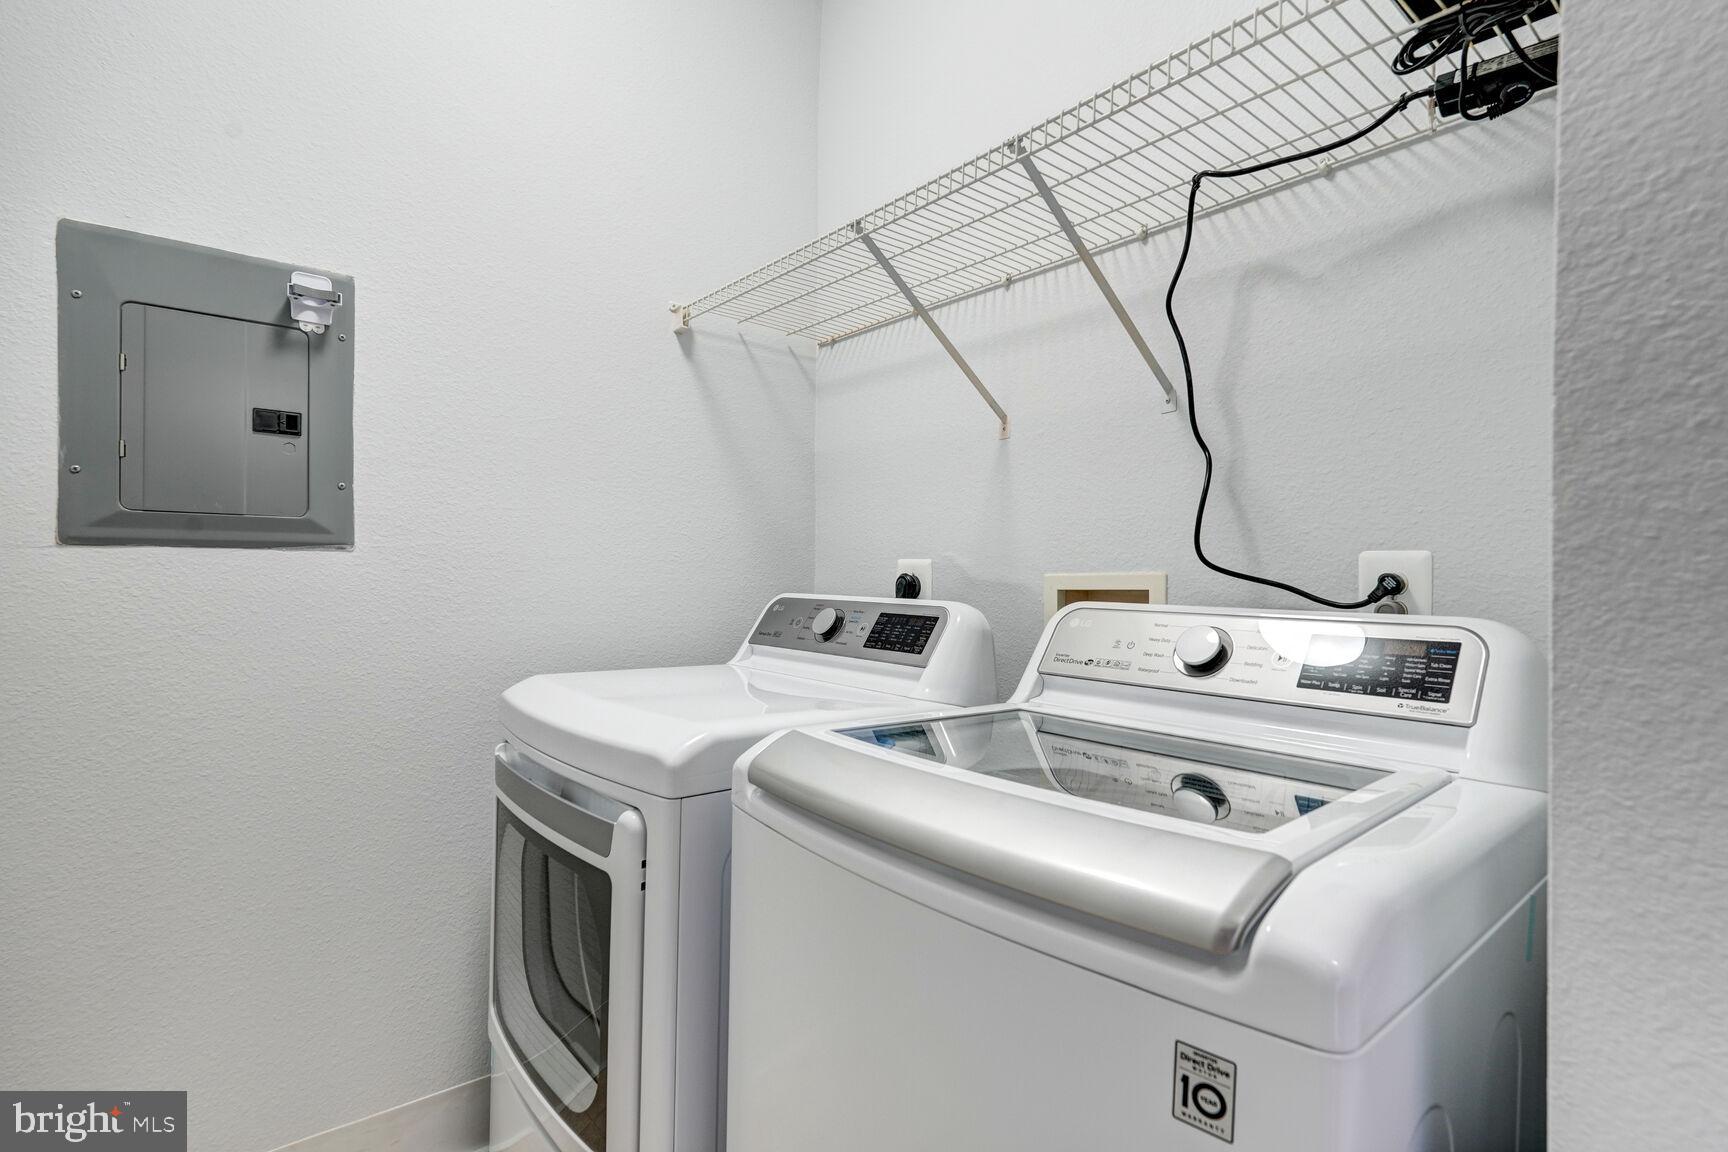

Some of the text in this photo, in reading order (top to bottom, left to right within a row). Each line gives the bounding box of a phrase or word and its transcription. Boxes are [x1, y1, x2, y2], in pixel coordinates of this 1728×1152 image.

[1080, 618, 1093, 628] LG
[1053, 656, 1084, 666] DirectDrive
[1180, 1051, 1231, 1079] Direct Drive
[1181, 1073, 1227, 1120] 10
